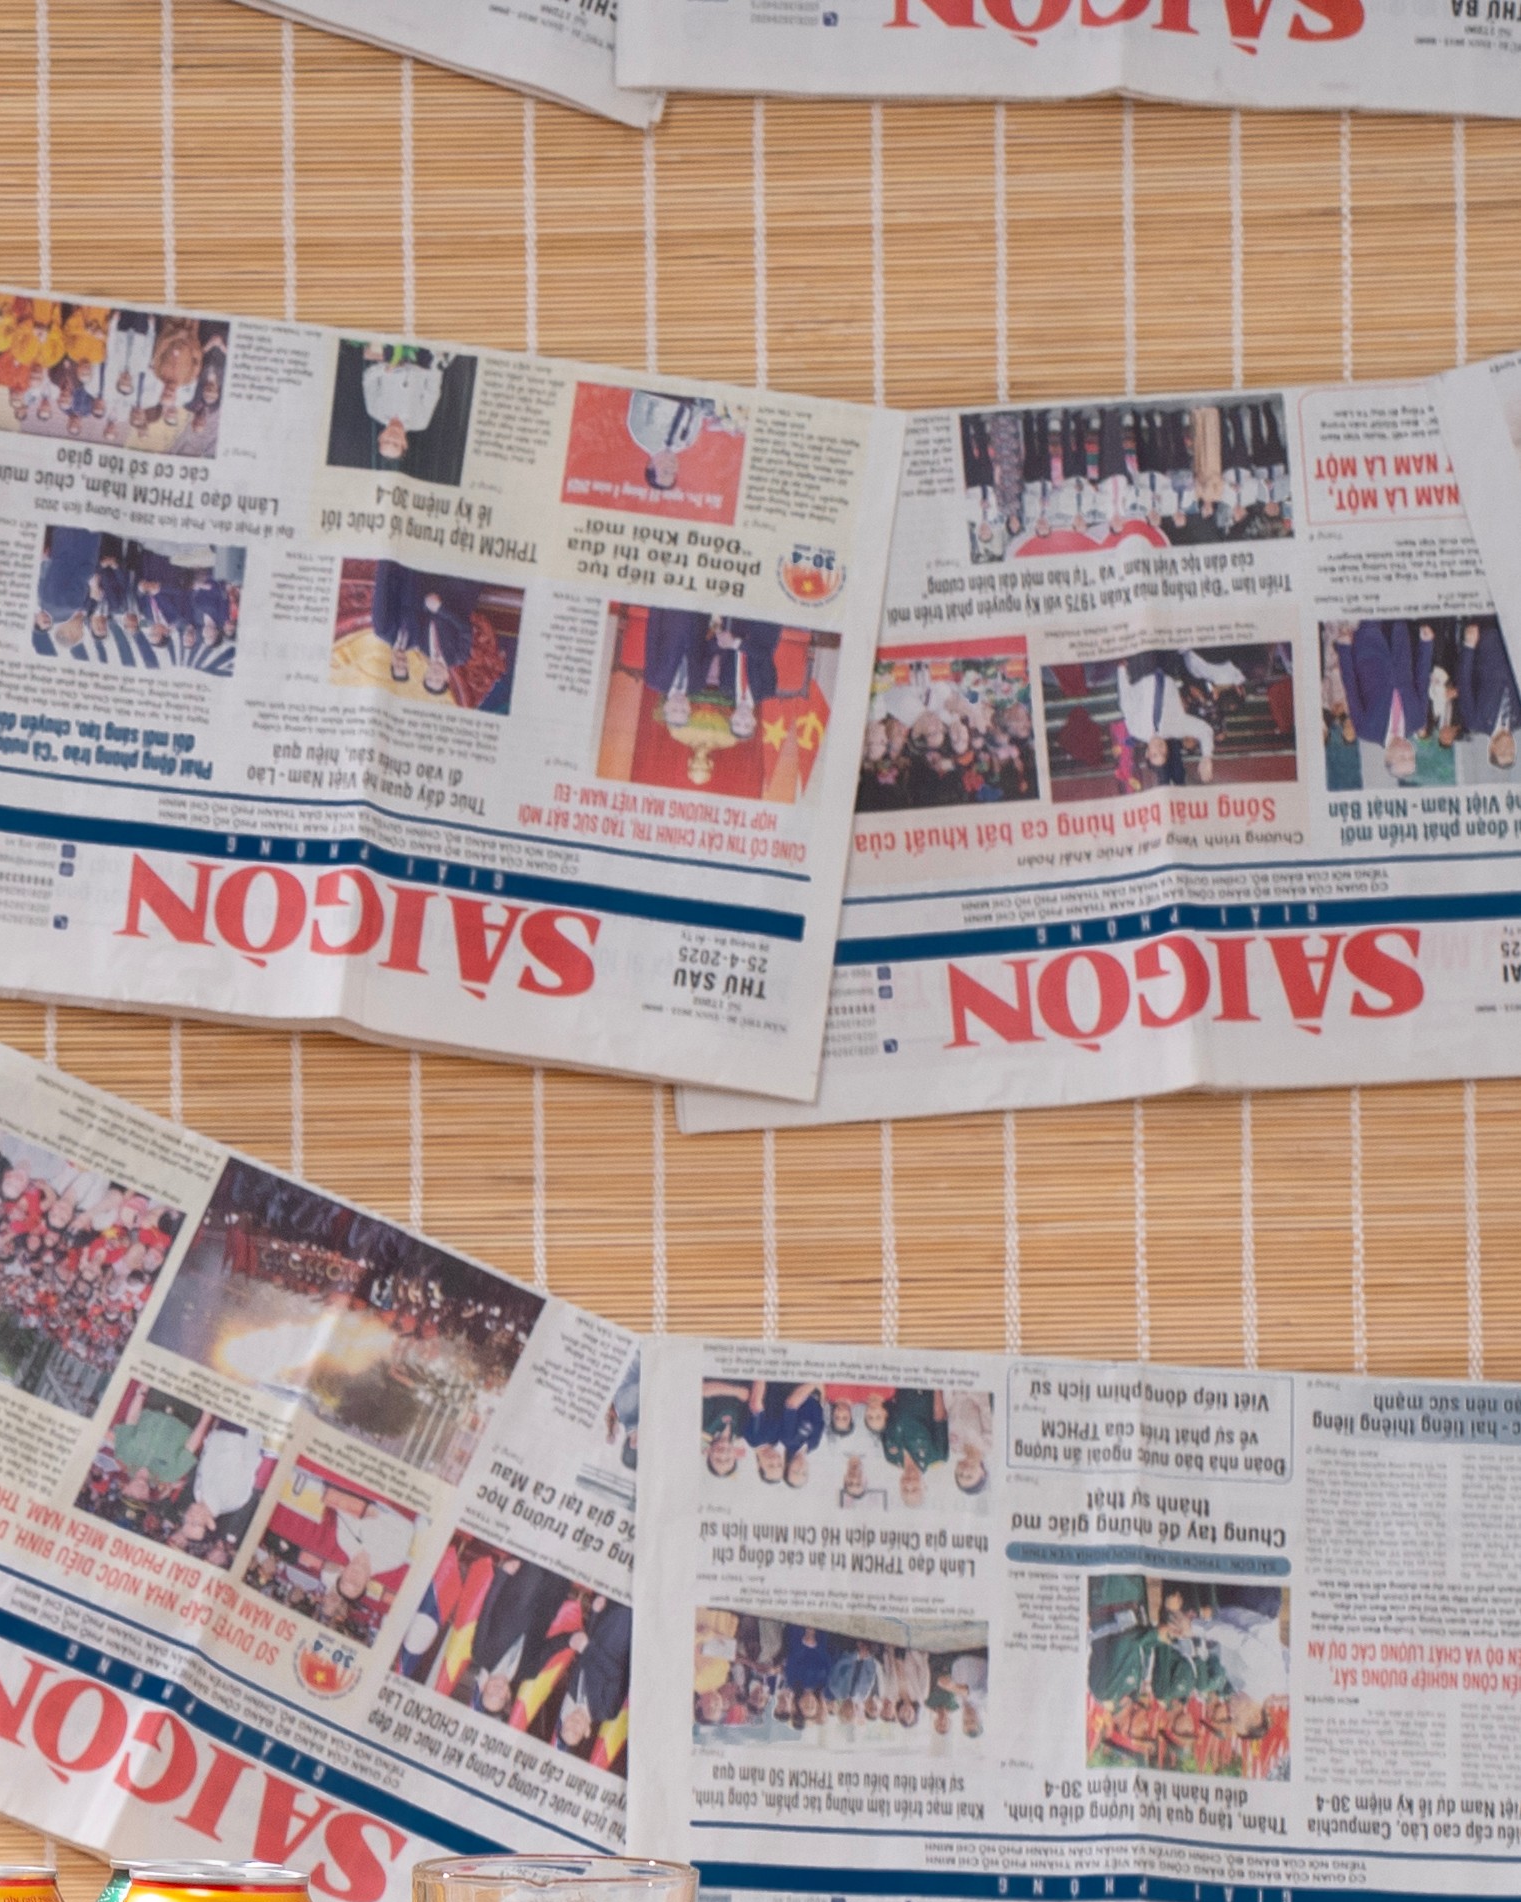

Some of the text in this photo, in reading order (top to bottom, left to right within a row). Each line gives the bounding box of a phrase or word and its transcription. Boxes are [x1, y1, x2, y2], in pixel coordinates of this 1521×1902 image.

[34, 468, 75, 492] chúc
[56, 446, 209, 484] các cơ sở tôn giáo
[1314, 452, 1438, 483] NAM LÀ MỘT
[80, 474, 127, 500] thăm,
[131, 484, 194, 509] TPHCM
[199, 489, 232, 512] đạo
[1328, 482, 1459, 514] NAM LÀ MỘT,
[236, 494, 279, 516] Lãnh
[566, 537, 761, 577] phong trào thi đua
[791, 550, 835, 571] 30-4
[576, 559, 745, 598] Bến Tre tiếp tục
[851, 793, 1276, 859] Sống mãi bản hùng ca bất khuất của
[678, 945, 768, 974] 25-4-2025
[672, 967, 765, 999] THỨ SÁU
[1029, 1379, 1269, 1412] Viết tiếp dòng phim lịch sử
[1373, 1390, 1498, 1414] nên sức mạnh
[1311, 1409, 1497, 1439] hai tiếng thiêng liêng
[489, 1460, 616, 1527] gia tại Cà Mau
[1086, 1489, 1210, 1517] thành sự thật
[475, 1484, 604, 1552] cấp trường học
[1010, 1512, 1286, 1548] Chung tay để những giấc mơ
[1315, 1792, 1495, 1818] Nam dự lễ kỷ niệm 30-4
[1306, 1815, 1493, 1843] cấp cao Lào, Campuchia
